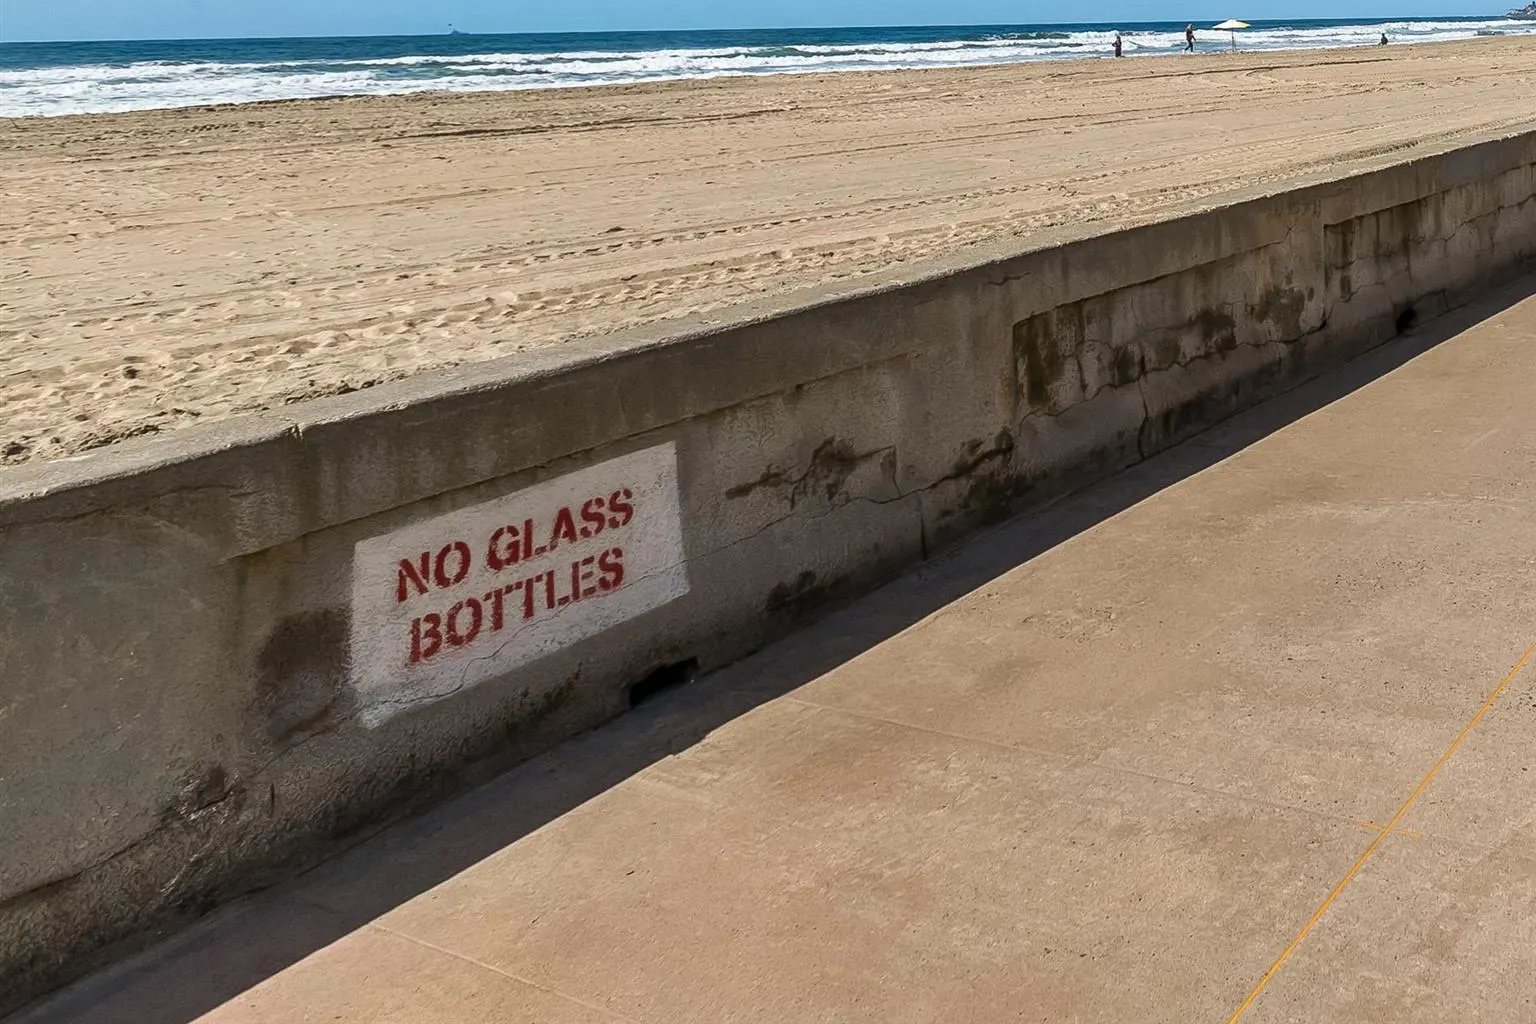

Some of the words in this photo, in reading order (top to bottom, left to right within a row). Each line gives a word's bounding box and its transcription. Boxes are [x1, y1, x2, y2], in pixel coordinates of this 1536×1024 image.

[395, 541, 471, 603] NO
[486, 487, 634, 573] GLASS
[405, 547, 625, 665] BOTTLES
